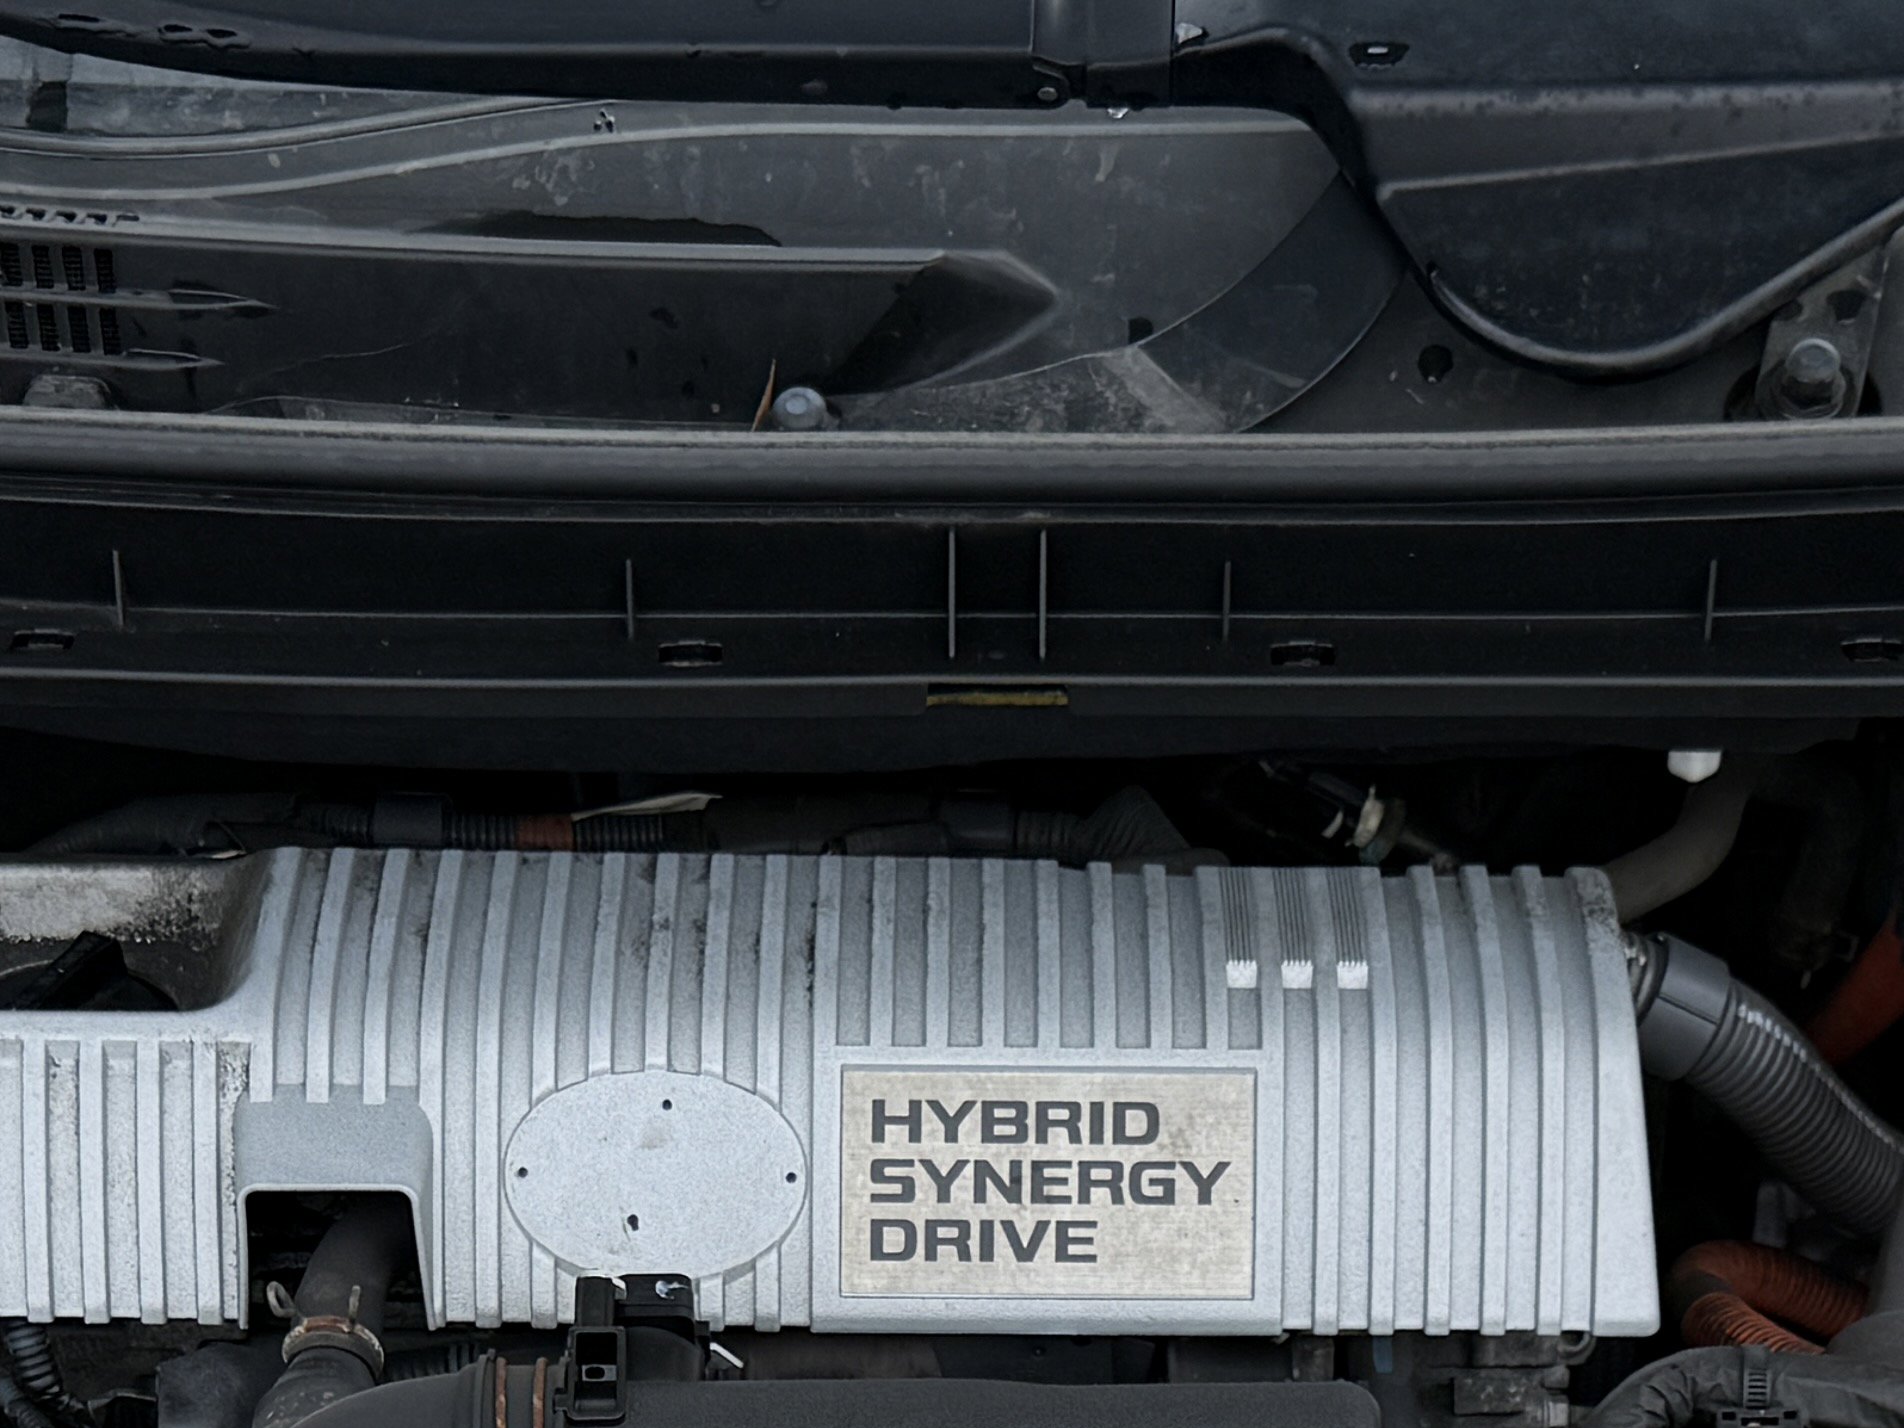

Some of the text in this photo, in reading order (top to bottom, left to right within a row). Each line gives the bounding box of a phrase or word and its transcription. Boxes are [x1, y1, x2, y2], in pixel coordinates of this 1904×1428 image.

[871, 1099, 1160, 1145] HYBRID
[870, 1158, 1232, 1205] SYNERGY
[870, 1218, 1099, 1263] DRIVE
